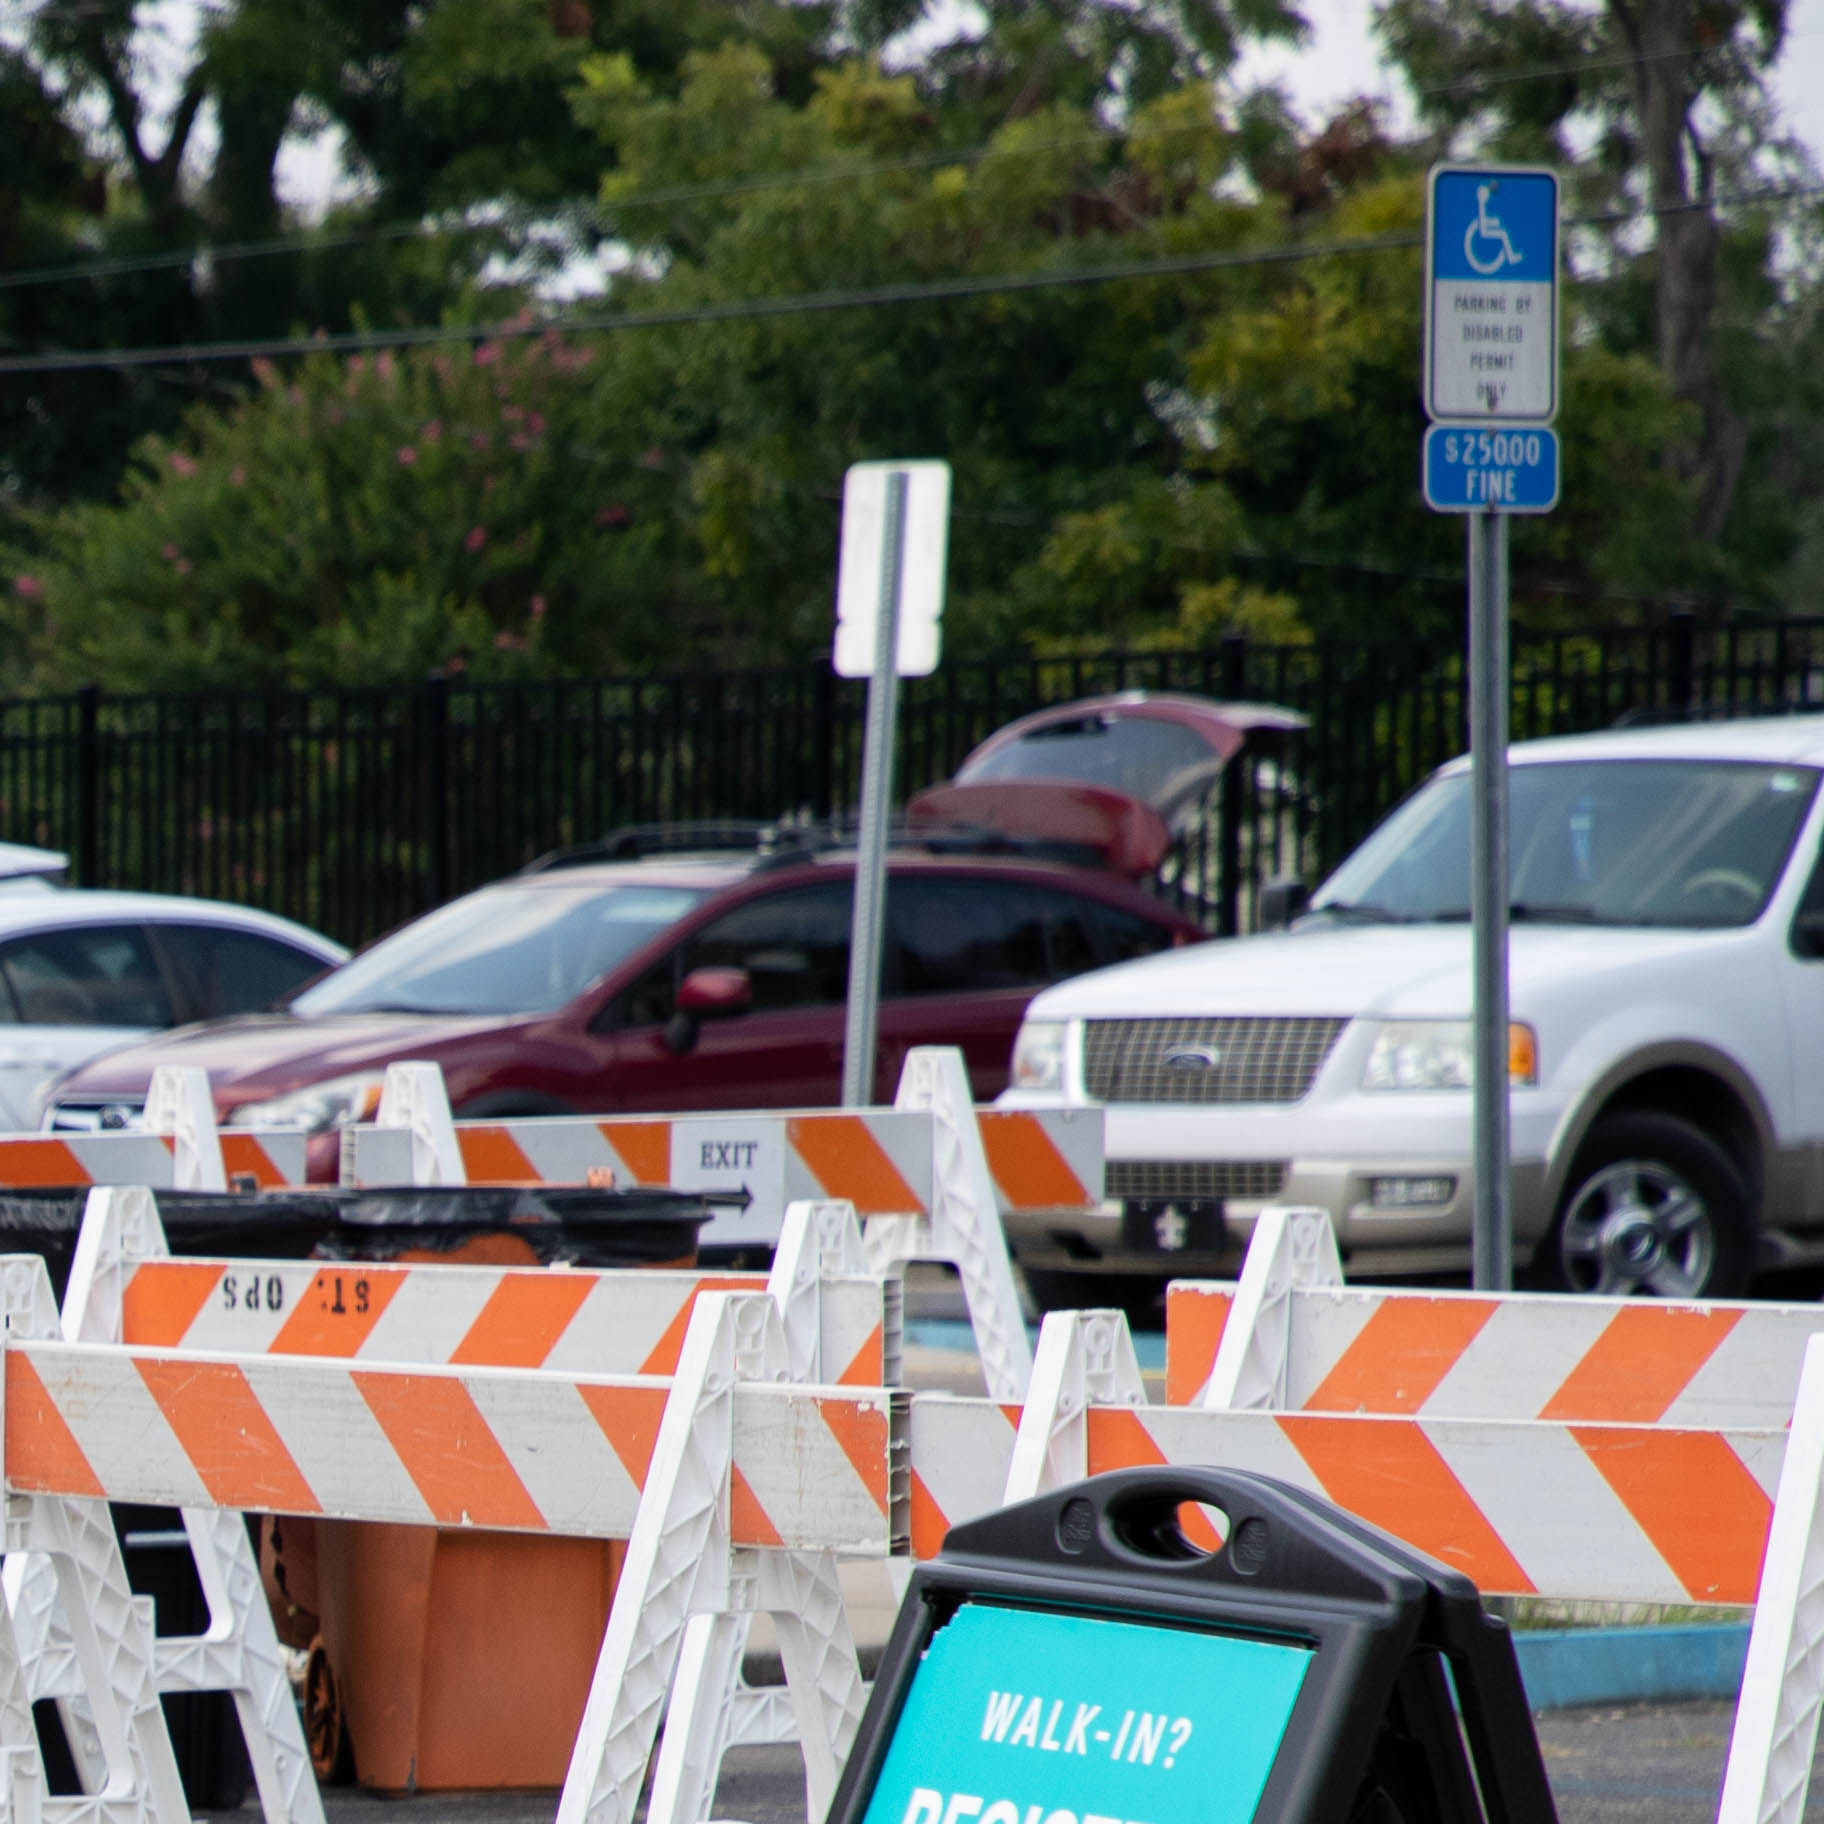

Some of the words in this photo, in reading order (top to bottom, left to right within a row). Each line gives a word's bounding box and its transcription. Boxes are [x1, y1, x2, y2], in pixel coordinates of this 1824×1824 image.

[1466, 469, 1517, 501] FINE
[701, 1141, 758, 1169] EXIT
[223, 1274, 283, 1311] OPS
[981, 1691, 1193, 1769] WALK-IN?
